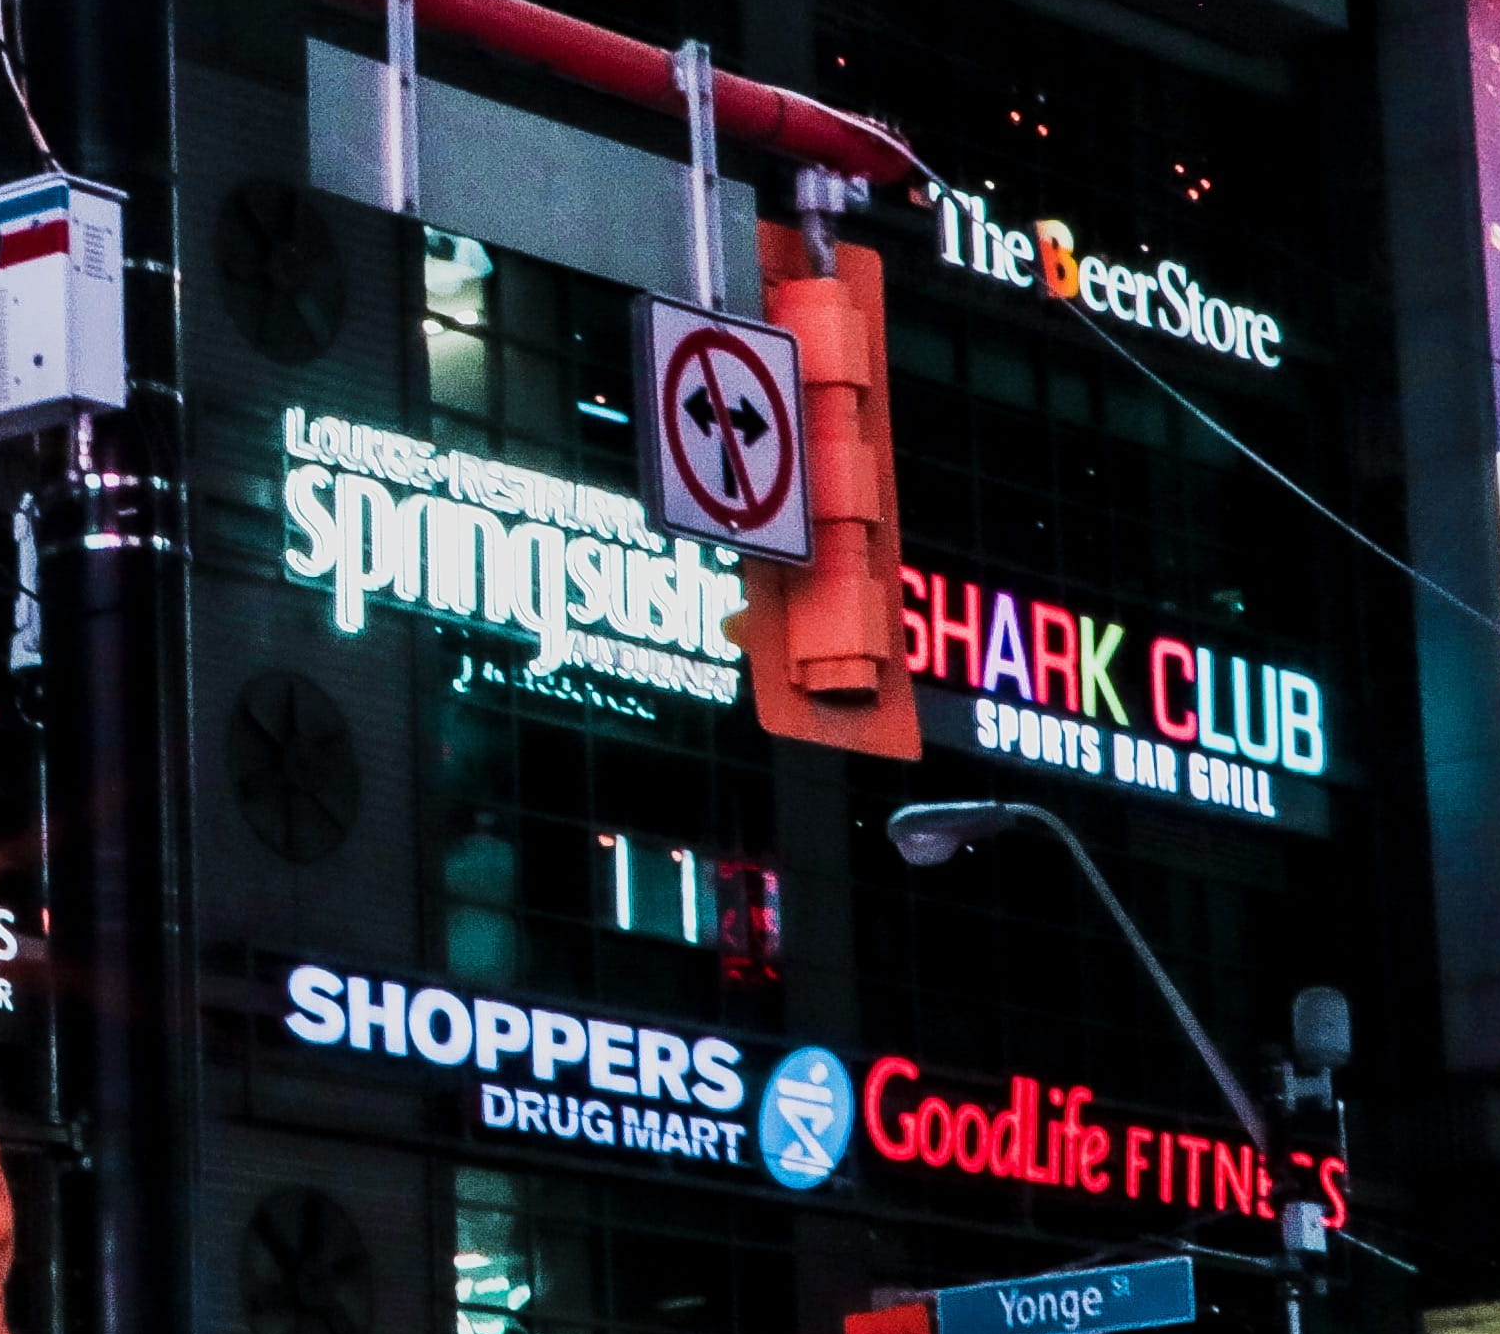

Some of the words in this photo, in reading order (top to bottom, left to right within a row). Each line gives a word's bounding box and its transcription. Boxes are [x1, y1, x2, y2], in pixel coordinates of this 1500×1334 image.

[927, 180, 1035, 288] The
[901, 564, 1130, 727] SHARK
[1150, 635, 1326, 777] CLUB
[974, 697, 1102, 776] SPORTS
[1113, 732, 1179, 794] BAR
[1187, 751, 1277, 819] GRILL
[284, 963, 745, 1112] SHOPPERS
[480, 1082, 614, 1144] DRUG
[622, 1105, 746, 1163] MART
[865, 1056, 1110, 1193] GoodLife
[998, 1286, 1104, 1330] Yonge
